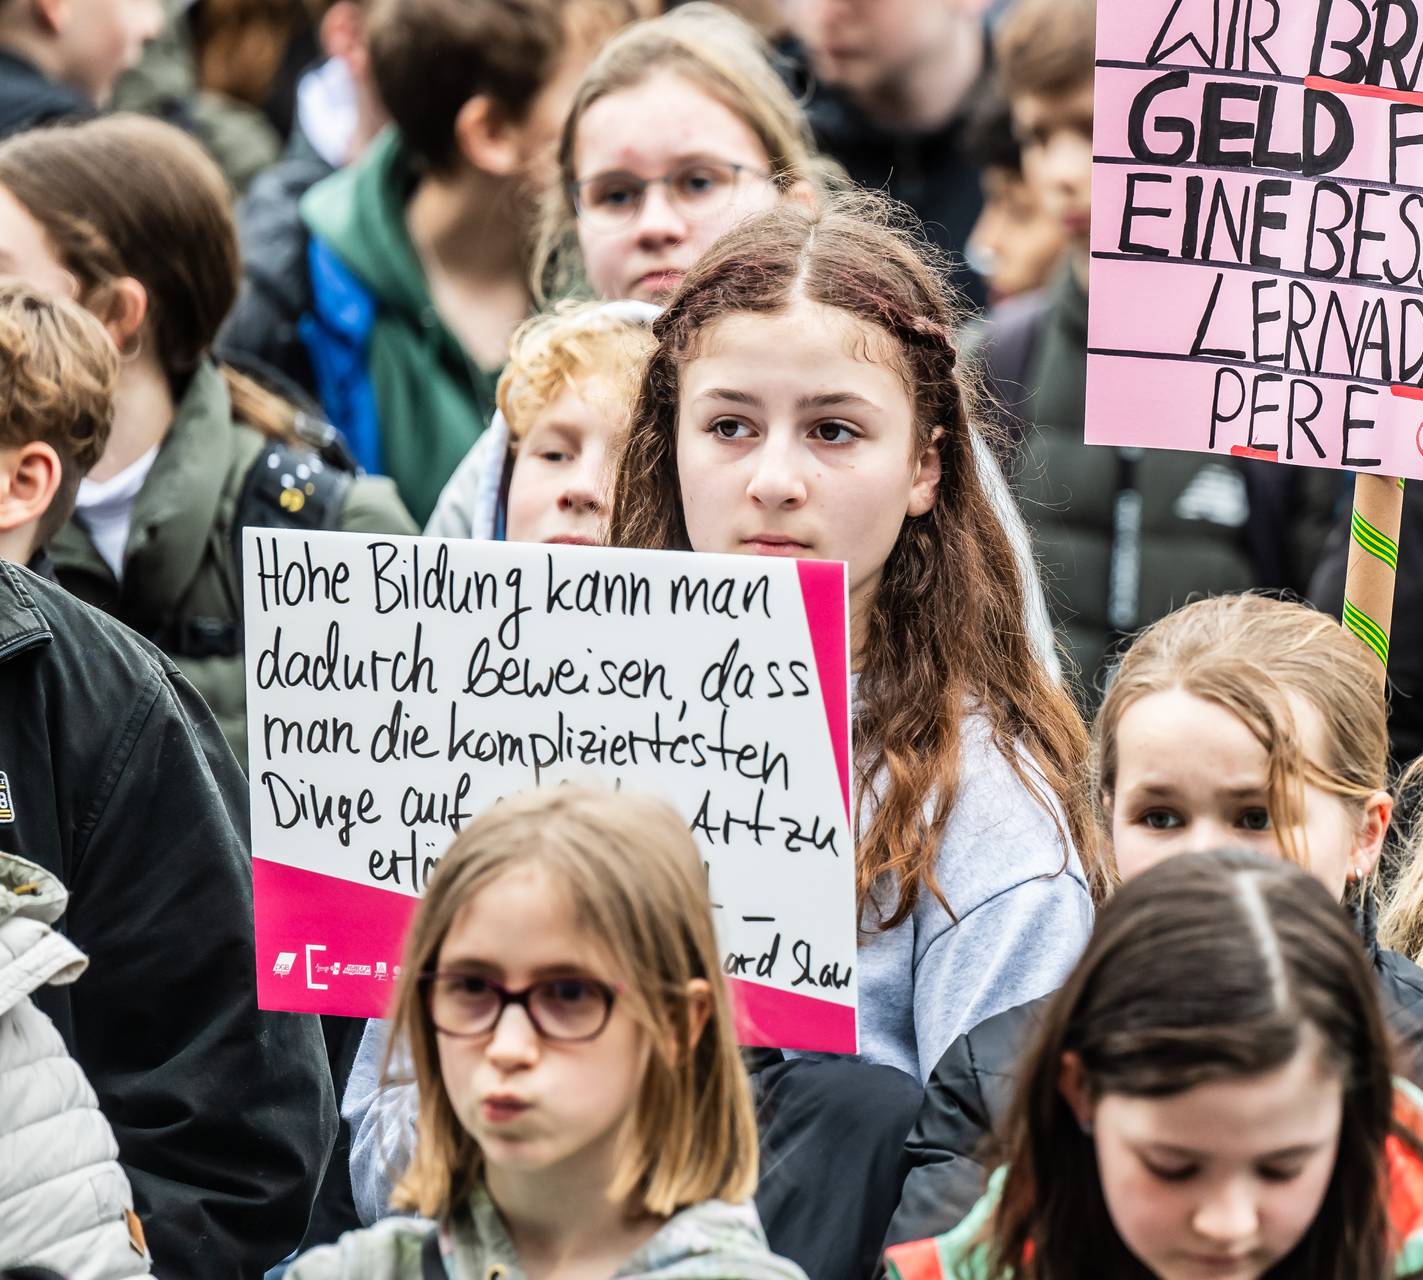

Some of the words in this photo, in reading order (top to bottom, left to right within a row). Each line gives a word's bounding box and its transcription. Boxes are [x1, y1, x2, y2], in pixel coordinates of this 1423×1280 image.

[1145, 0, 1281, 76] WIR
[1128, 70, 1354, 177] GELD
[1117, 173, 1291, 269] EINE
[1209, 367, 1381, 468] PERE
[256, 537, 350, 611] Hohe
[367, 542, 532, 650] Bildung
[546, 553, 651, 616] kann
[670, 574, 771, 618] man
[256, 620, 437, 693] dadurch
[462, 637, 687, 722] beweisen,
[701, 638, 810, 708] dass
[264, 713, 360, 760] man
[370, 699, 440, 763] die
[447, 701, 788, 791] kompliziertesten
[261, 771, 382, 847] Dinge
[400, 772, 472, 840] auf
[690, 788, 775, 845] Art
[779, 815, 839, 857] zu
[791, 939, 852, 989] Shaw
